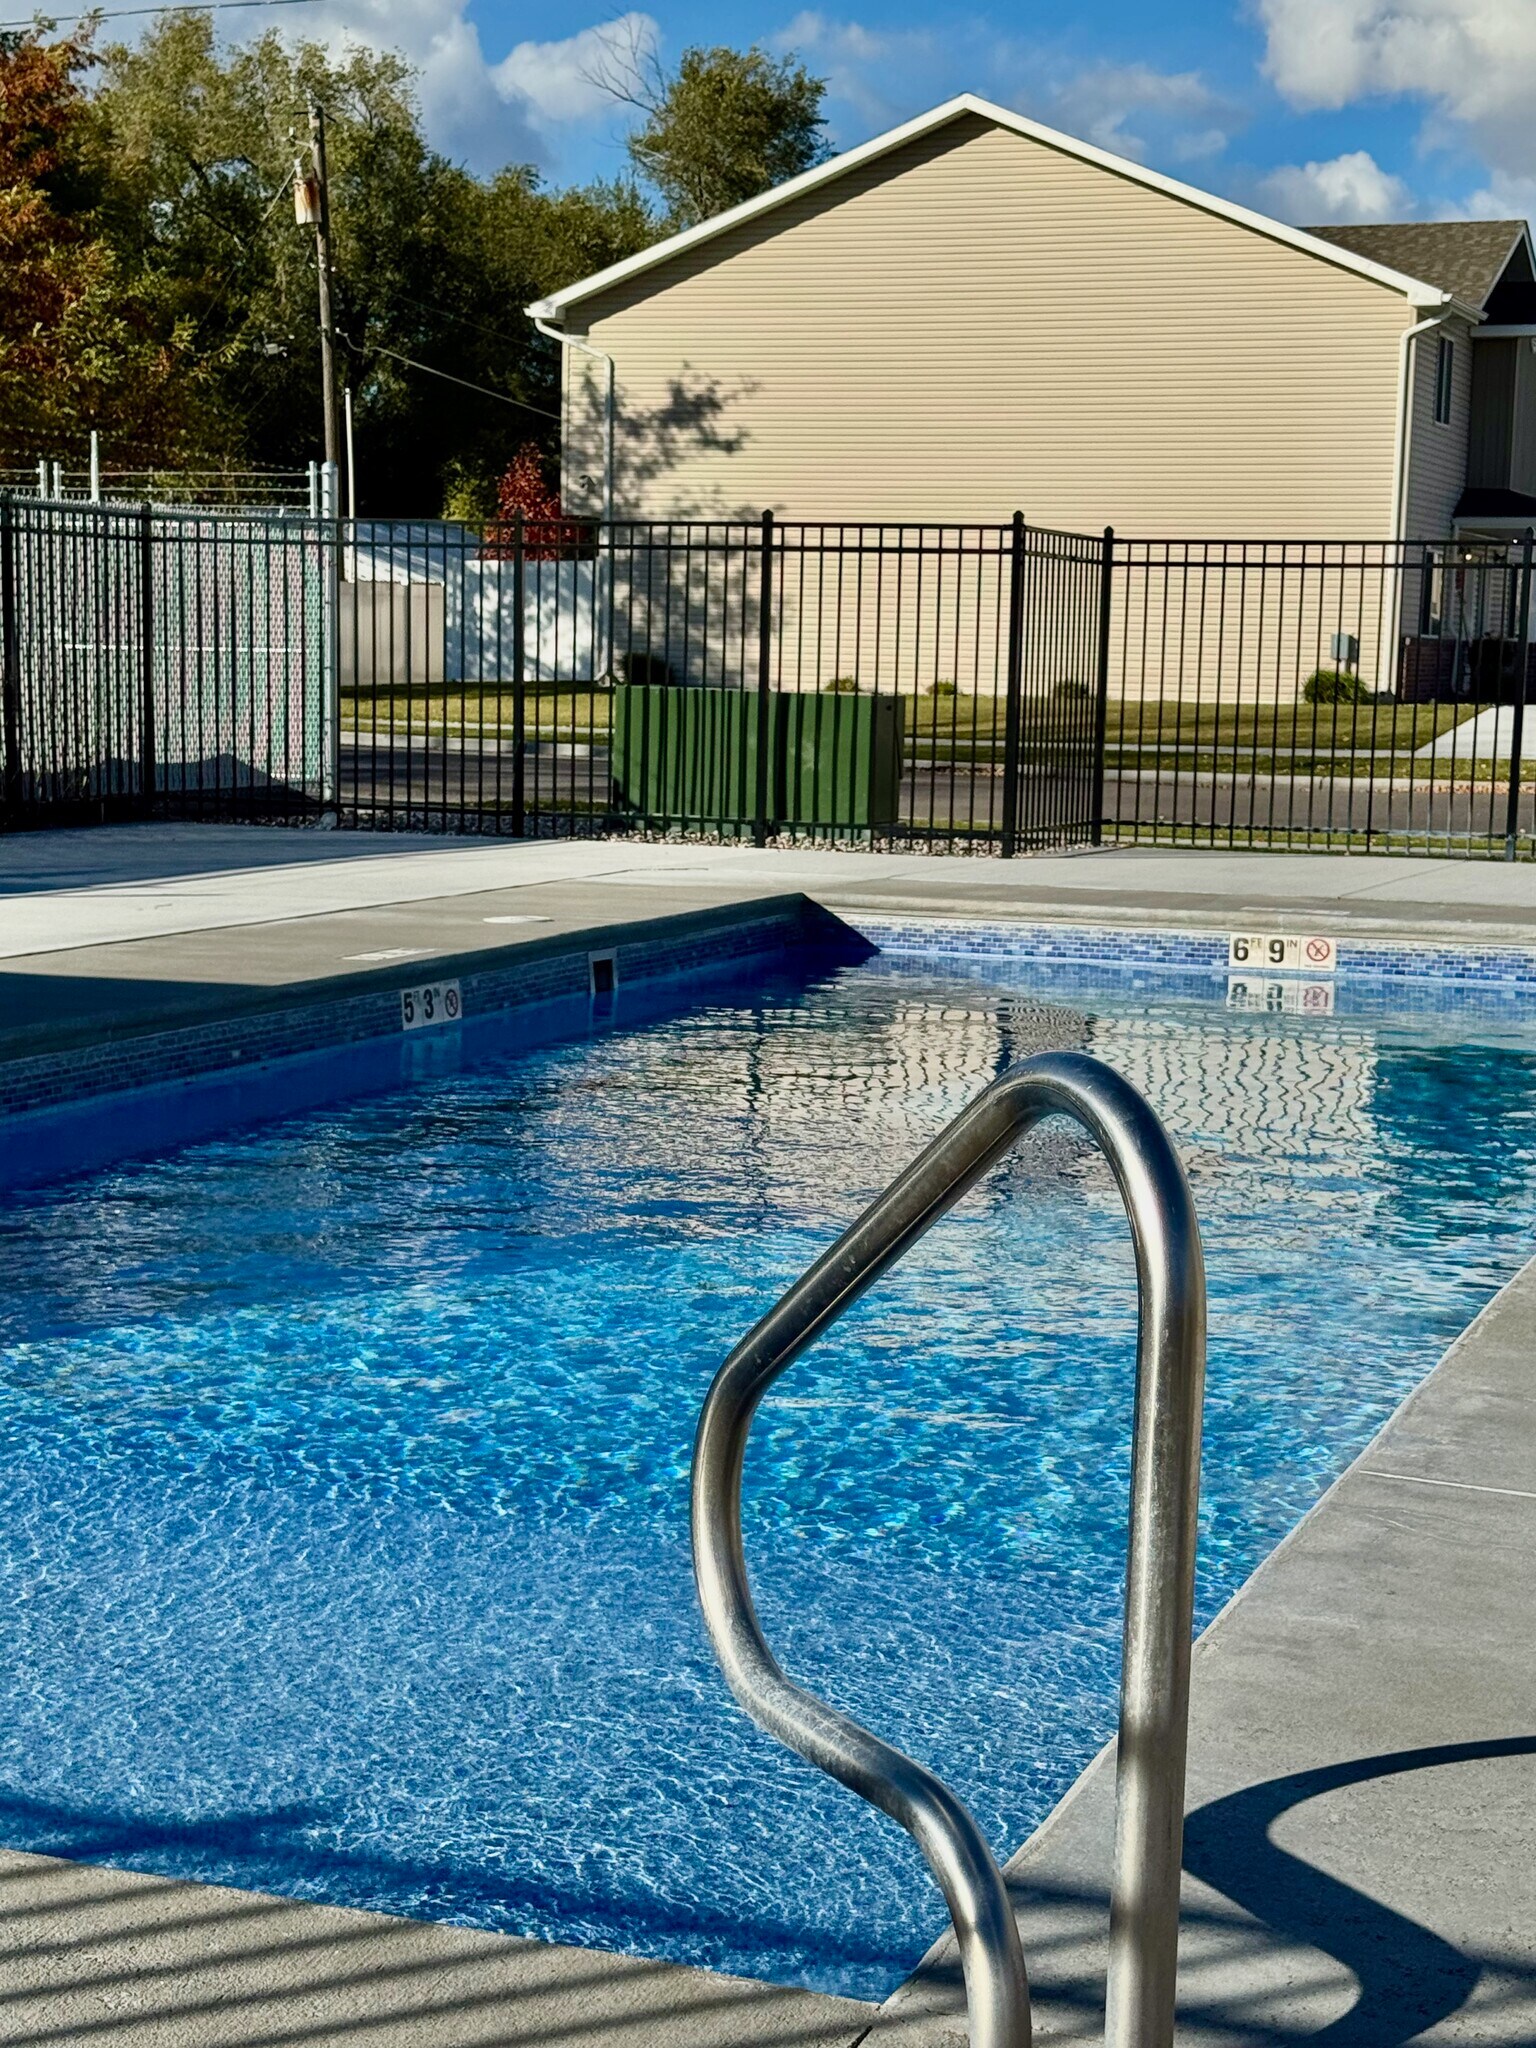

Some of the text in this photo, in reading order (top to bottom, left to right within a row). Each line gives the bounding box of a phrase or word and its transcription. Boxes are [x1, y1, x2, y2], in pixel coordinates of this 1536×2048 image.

[1233, 938, 1298, 963] 6 FT 9 IN
[403, 992, 414, 1023] 5
[423, 989, 434, 1019] 3
